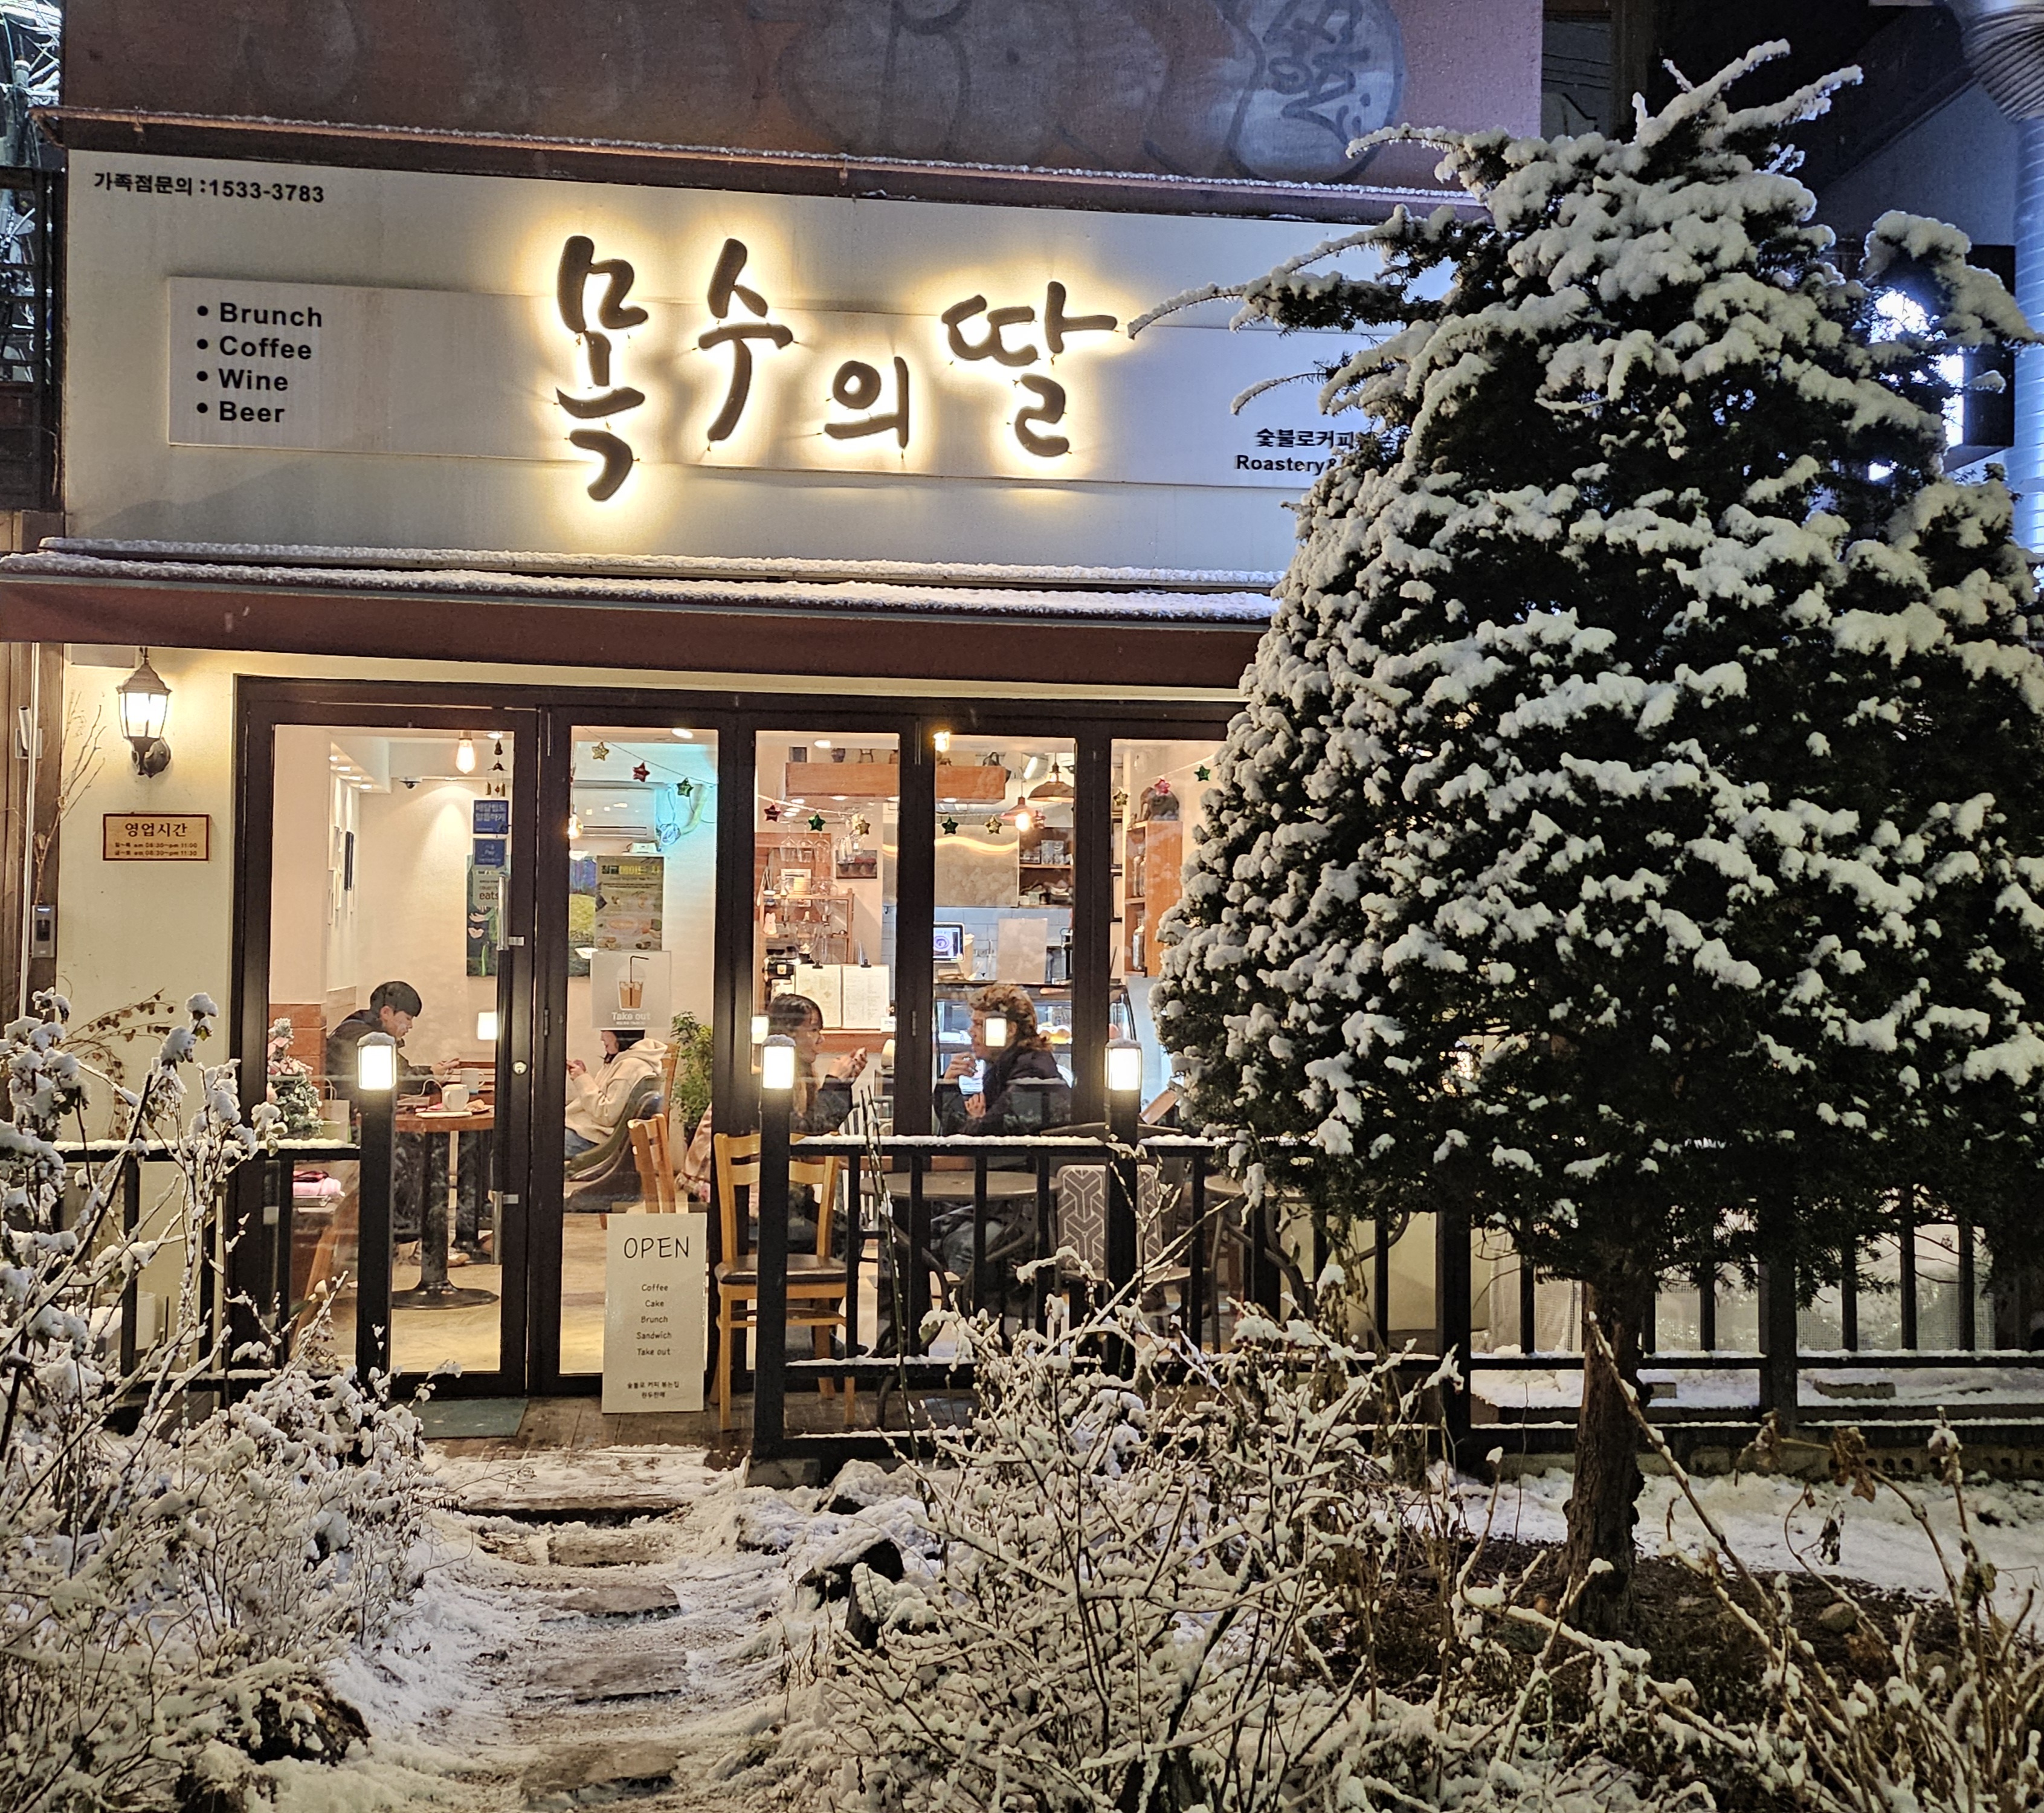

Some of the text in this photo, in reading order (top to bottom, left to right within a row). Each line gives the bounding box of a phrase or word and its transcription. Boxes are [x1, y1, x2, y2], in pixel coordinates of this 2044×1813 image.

[219, 302, 323, 328] Brunch
[219, 335, 312, 360] Coffee
[556, 234, 1118, 501] 목수의 딸
[218, 368, 289, 391] Wine
[219, 401, 285, 423] Beer
[125, 822, 188, 838] 영업시간
[611, 1012, 651, 1021] Take out
[624, 1236, 689, 1259] OPEN
[636, 1331, 672, 1340] Sandwich
